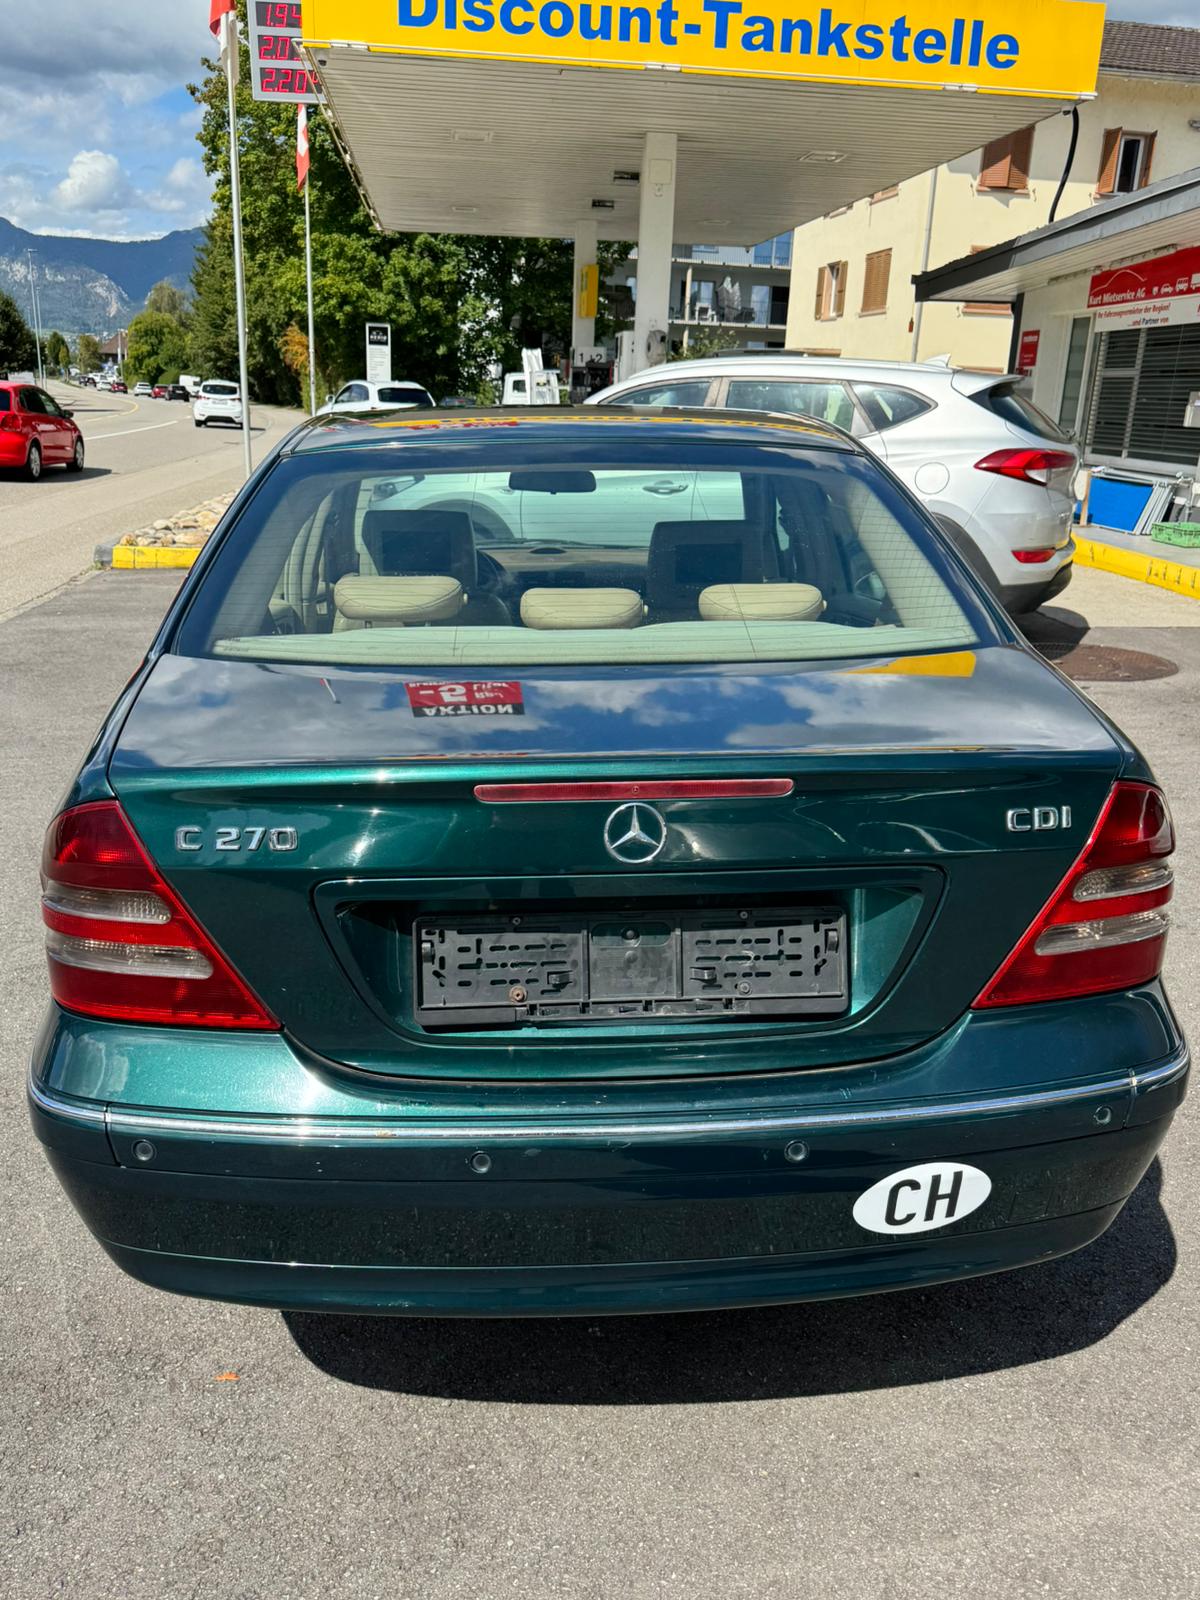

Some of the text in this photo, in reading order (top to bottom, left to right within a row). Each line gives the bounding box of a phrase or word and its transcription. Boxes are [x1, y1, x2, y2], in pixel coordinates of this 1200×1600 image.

[398, 0, 1020, 69] Discount-Tankstelle
[259, 36, 302, 61] 2.0
[1103, 289, 1136, 303] Mietservice
[1136, 286, 1146, 298] AG
[1142, 316, 1160, 325] Partner
[1143, 305, 1152, 313] der
[1005, 805, 1072, 833] CDI
[175, 826, 298, 852] C 270
[884, 1170, 964, 1227] CH
